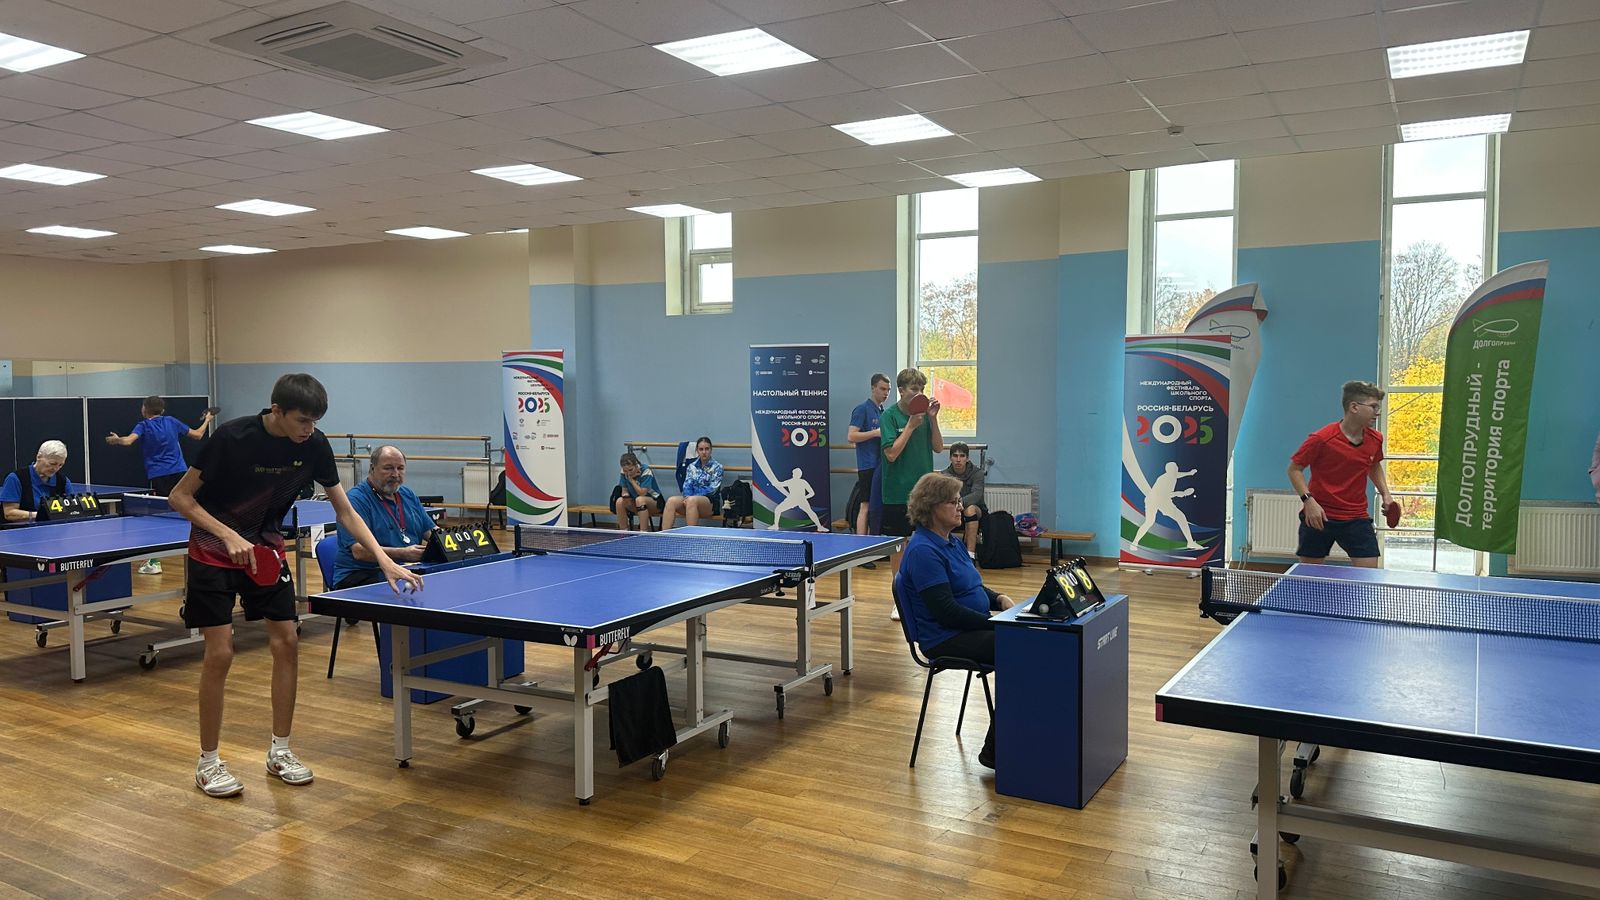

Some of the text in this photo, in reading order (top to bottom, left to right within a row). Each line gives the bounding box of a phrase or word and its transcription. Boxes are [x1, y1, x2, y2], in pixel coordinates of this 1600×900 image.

[518, 397, 550, 413] 2025
[781, 427, 827, 447] 2025
[1136, 414, 1214, 445] 2025
[1456, 374, 1482, 527] ДОЛГОПРУДНЫЙ
[1482, 360, 1511, 530] территория спорта
[51, 500, 63, 512] 4
[82, 496, 96, 508] 11
[444, 534, 458, 551] 4
[455, 532, 463, 541] 0
[463, 531, 471, 540] 0
[473, 530, 489, 546] 2
[60, 559, 94, 571] BUTTERFLY
[1059, 576, 1075, 599] 8
[1076, 568, 1092, 590] 8
[600, 626, 630, 646] BUTTERFLY
